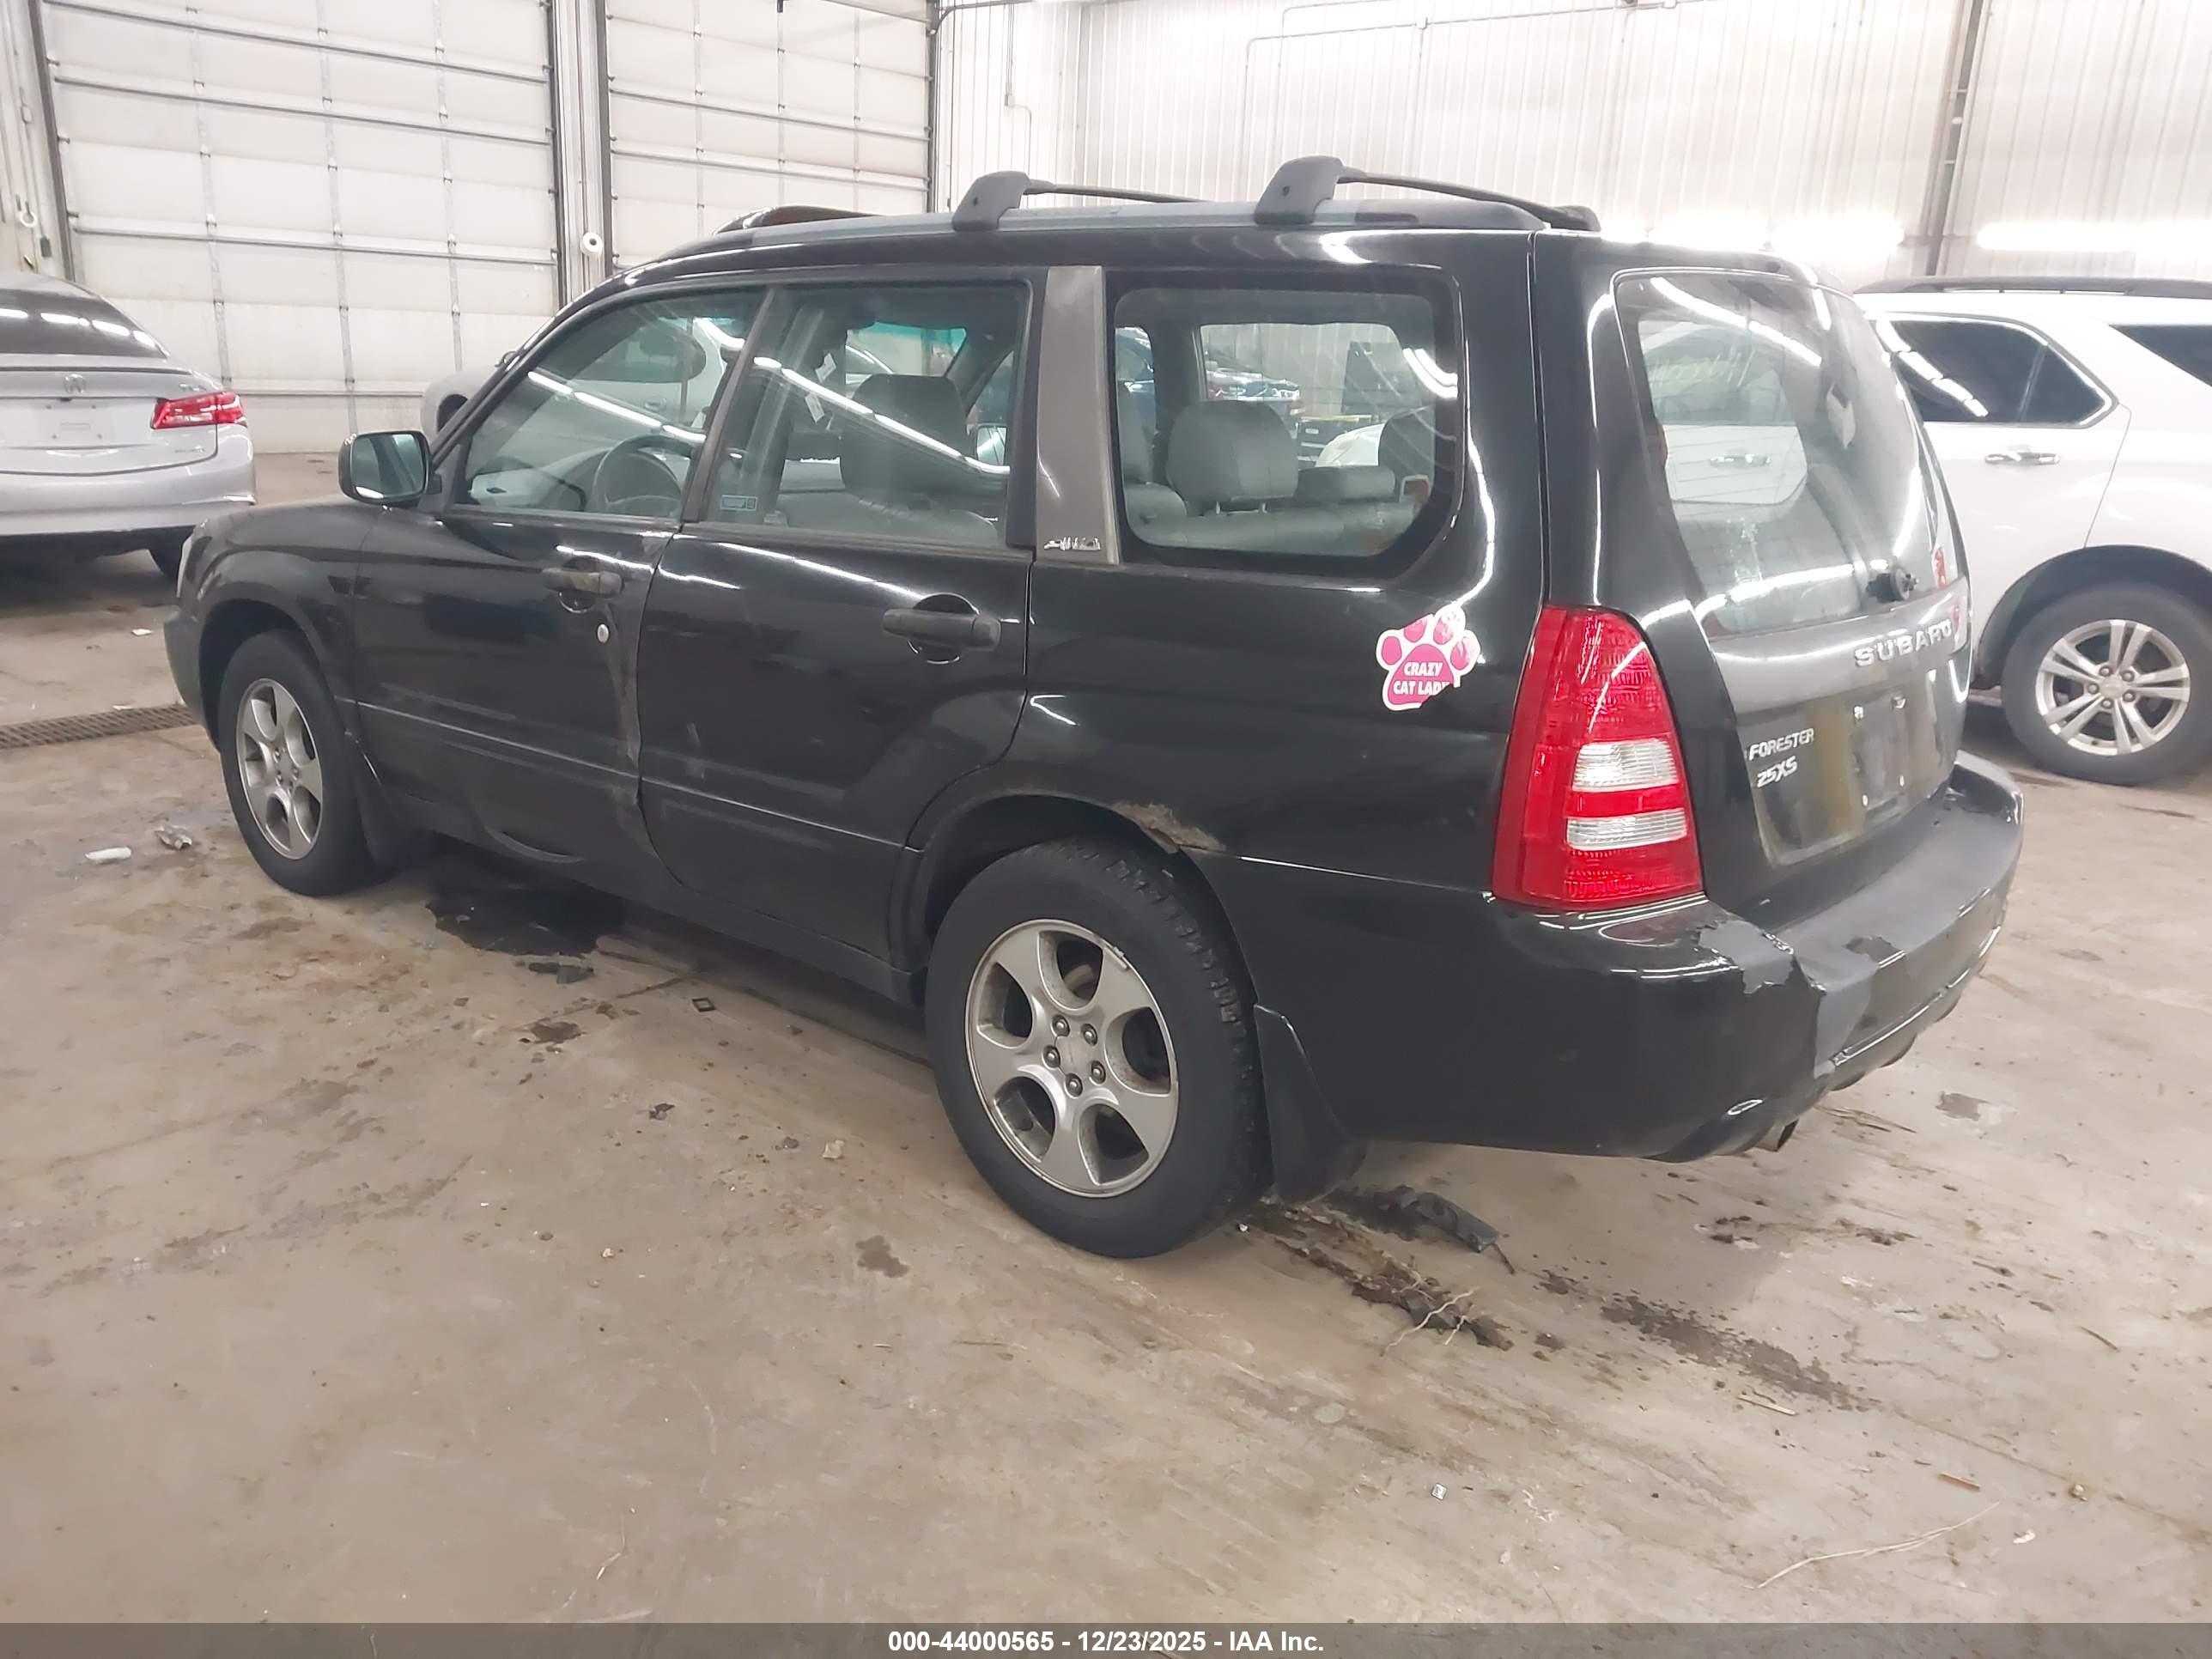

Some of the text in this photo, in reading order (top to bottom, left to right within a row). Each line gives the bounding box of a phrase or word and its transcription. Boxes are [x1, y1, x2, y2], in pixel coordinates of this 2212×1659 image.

[1854, 618, 1953, 667] SUBARU
[1403, 660, 1443, 677] CRAZY
[1393, 679, 1416, 695] CAT
[1748, 727, 1814, 761] FORESTER
